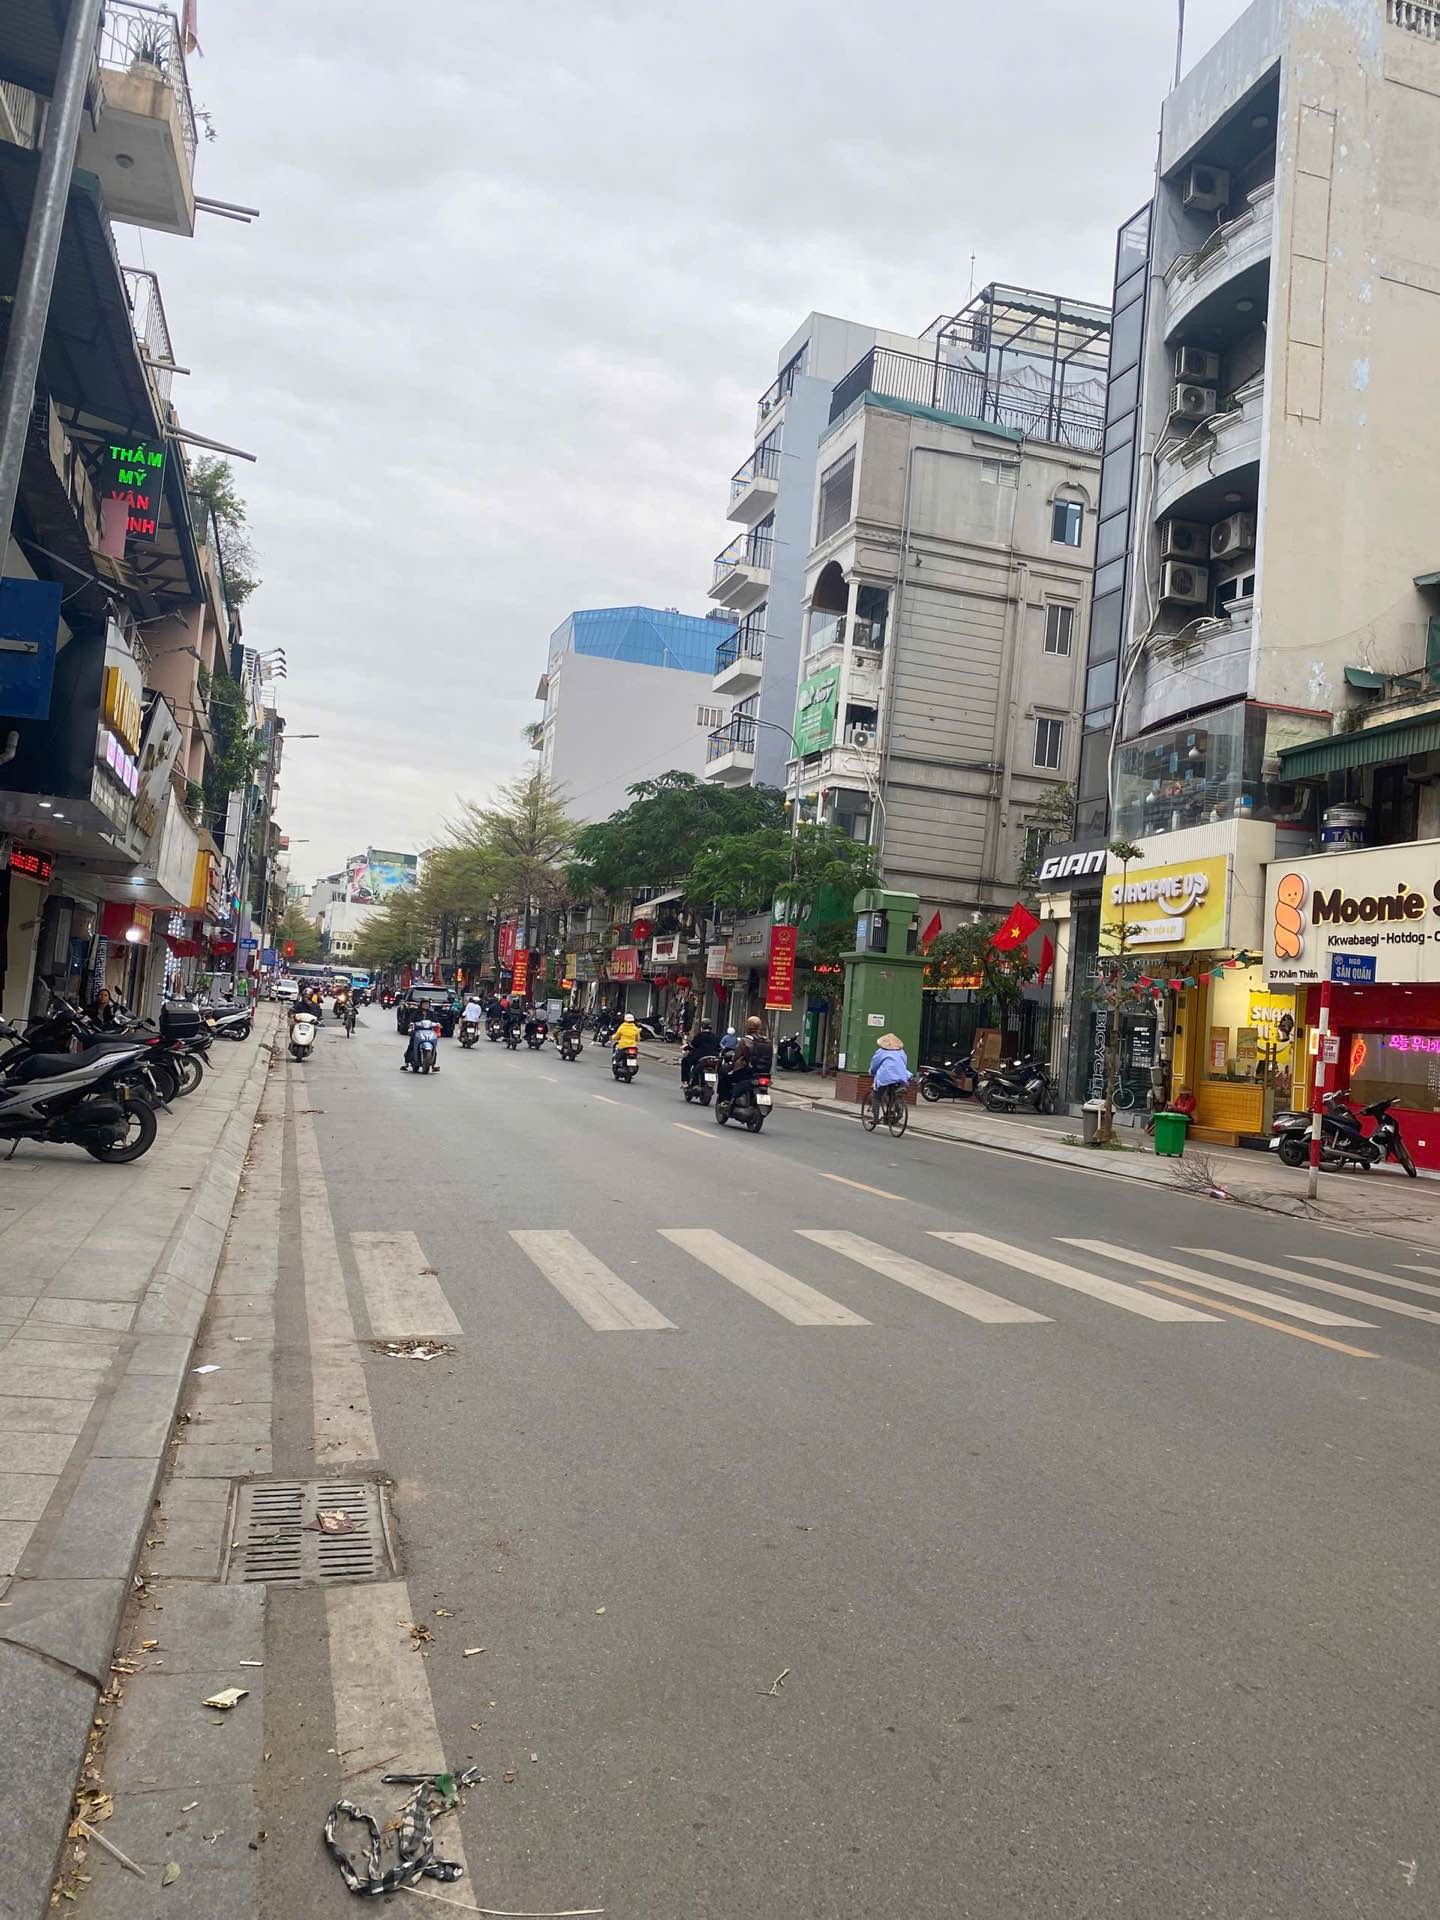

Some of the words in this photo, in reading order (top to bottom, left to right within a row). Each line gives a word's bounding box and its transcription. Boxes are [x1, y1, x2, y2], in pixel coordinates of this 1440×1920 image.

[118, 468, 147, 487] MỸ
[1332, 829, 1363, 842] TÂN
[1040, 850, 1105, 880] GIAN
[1312, 883, 1425, 926] Moonie
[1328, 934, 1380, 947] Kkwabaegi
[1386, 932, 1425, 945] Hotdog
[1269, 969, 1278, 979] 57
